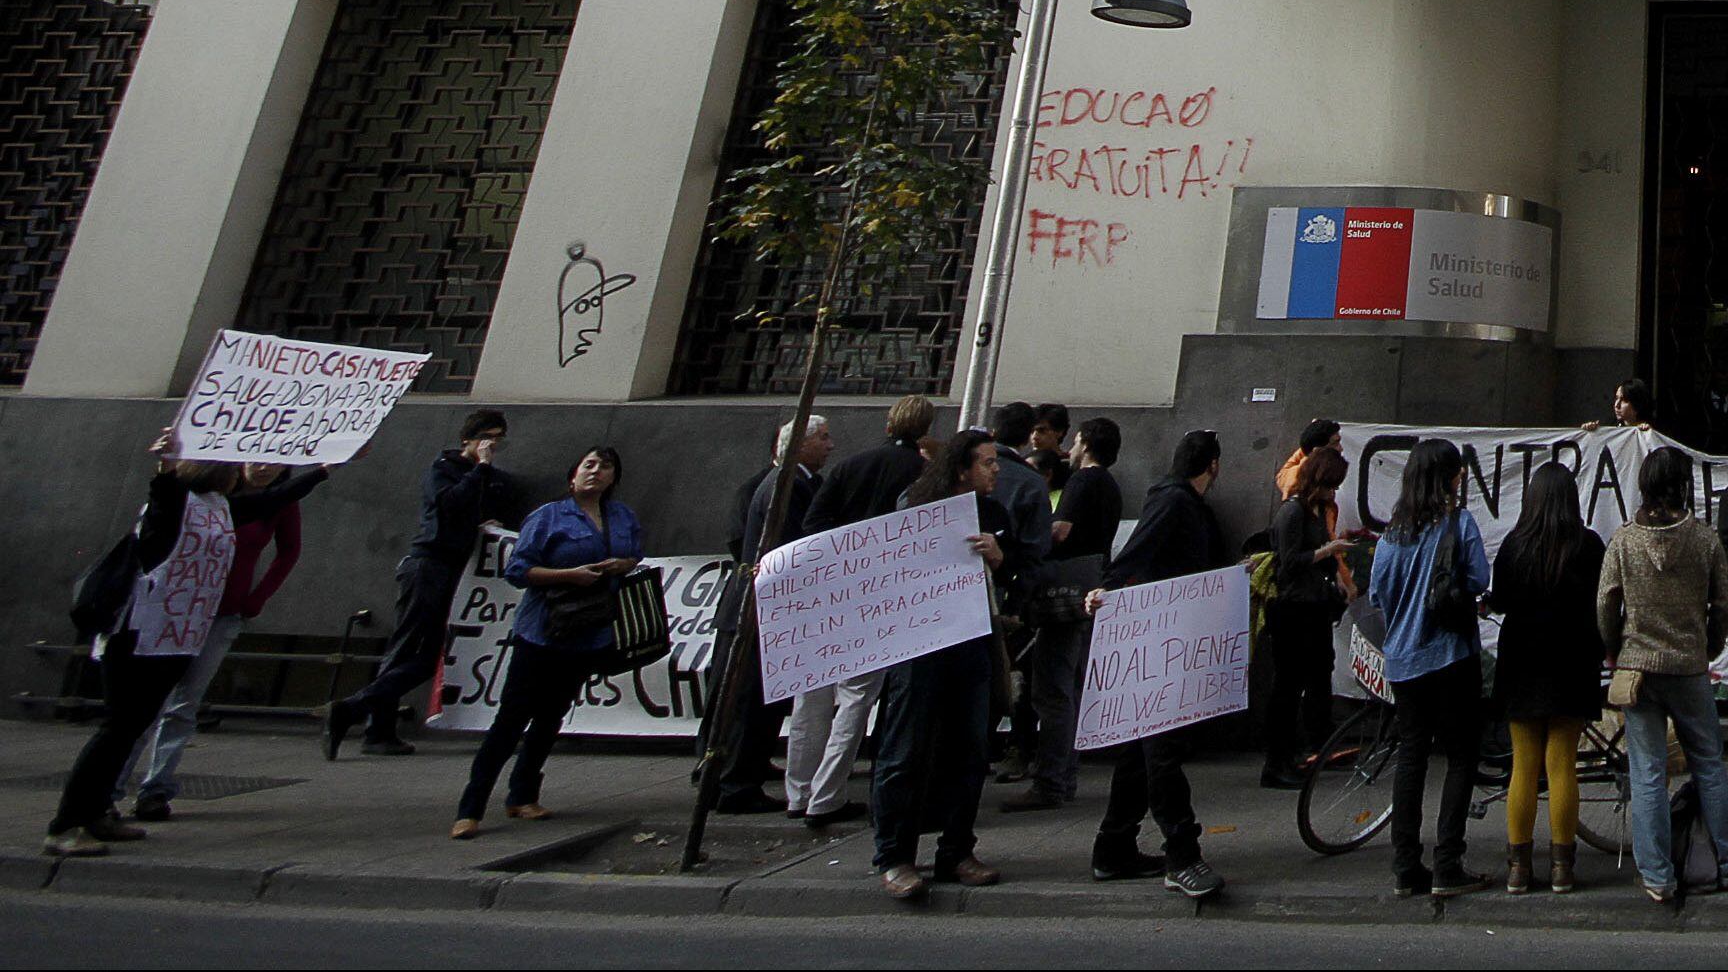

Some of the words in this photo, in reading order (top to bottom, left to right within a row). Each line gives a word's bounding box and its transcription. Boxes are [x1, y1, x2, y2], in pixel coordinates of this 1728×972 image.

[1347, 230, 1371, 238] Salud
[1348, 220, 1391, 229] Ministerio
[1393, 221, 1403, 229] de
[1430, 253, 1522, 278] Ministerio
[1525, 265, 1541, 282] de
[1428, 278, 1484, 299] Salud
[1339, 307, 1371, 315] Gobierno
[1382, 307, 1401, 315] Chile
[976, 323, 993, 348] 9
[199, 431, 226, 450] DE
[760, 550, 785, 576] NO
[791, 538, 824, 569] ES
[884, 516, 913, 543] LA
[916, 505, 960, 533] DEL
[843, 555, 870, 578] NO
[460, 587, 517, 622] Par
[830, 590, 851, 605] NI
[856, 595, 908, 623] PARA
[1099, 586, 1163, 622] SALUD
[1167, 575, 1225, 605] DIGNA
[766, 655, 806, 678] DEL
[877, 625, 897, 639] DE
[1088, 650, 1121, 692] NO
[1121, 645, 1158, 686] AL
